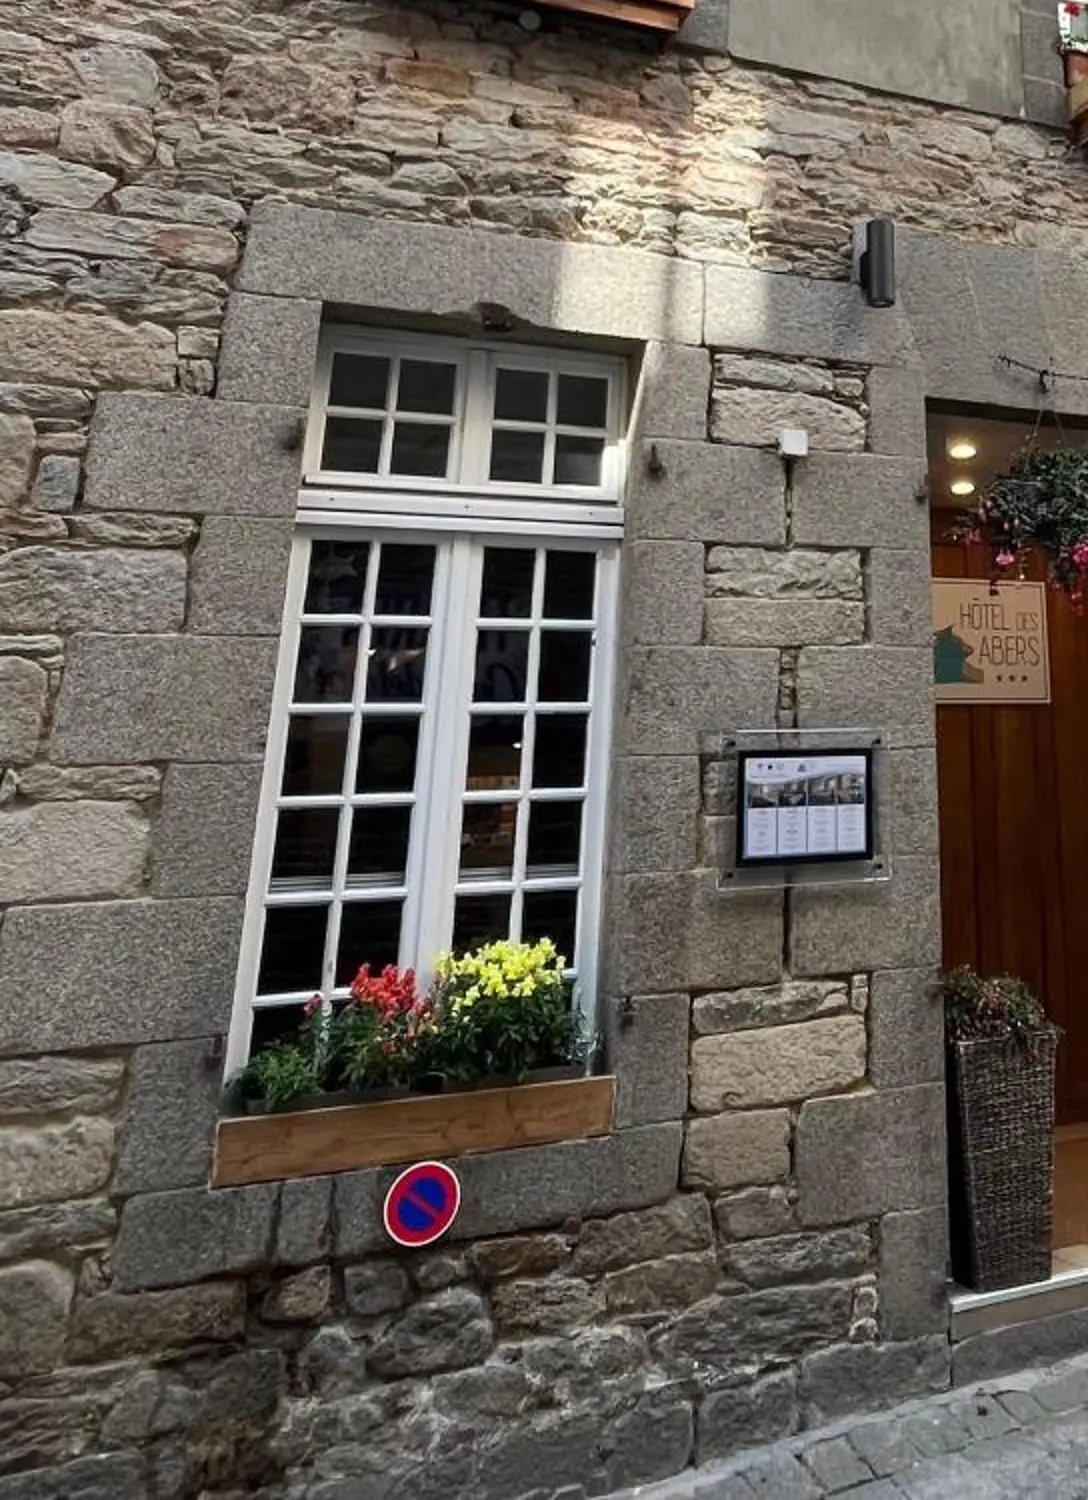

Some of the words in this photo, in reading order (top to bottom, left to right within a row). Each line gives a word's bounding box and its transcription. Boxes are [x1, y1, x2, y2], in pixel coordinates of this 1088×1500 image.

[959, 597, 1011, 631] HÔTEL
[1015, 612, 1039, 631] DES
[979, 636, 1041, 668] ABERS
